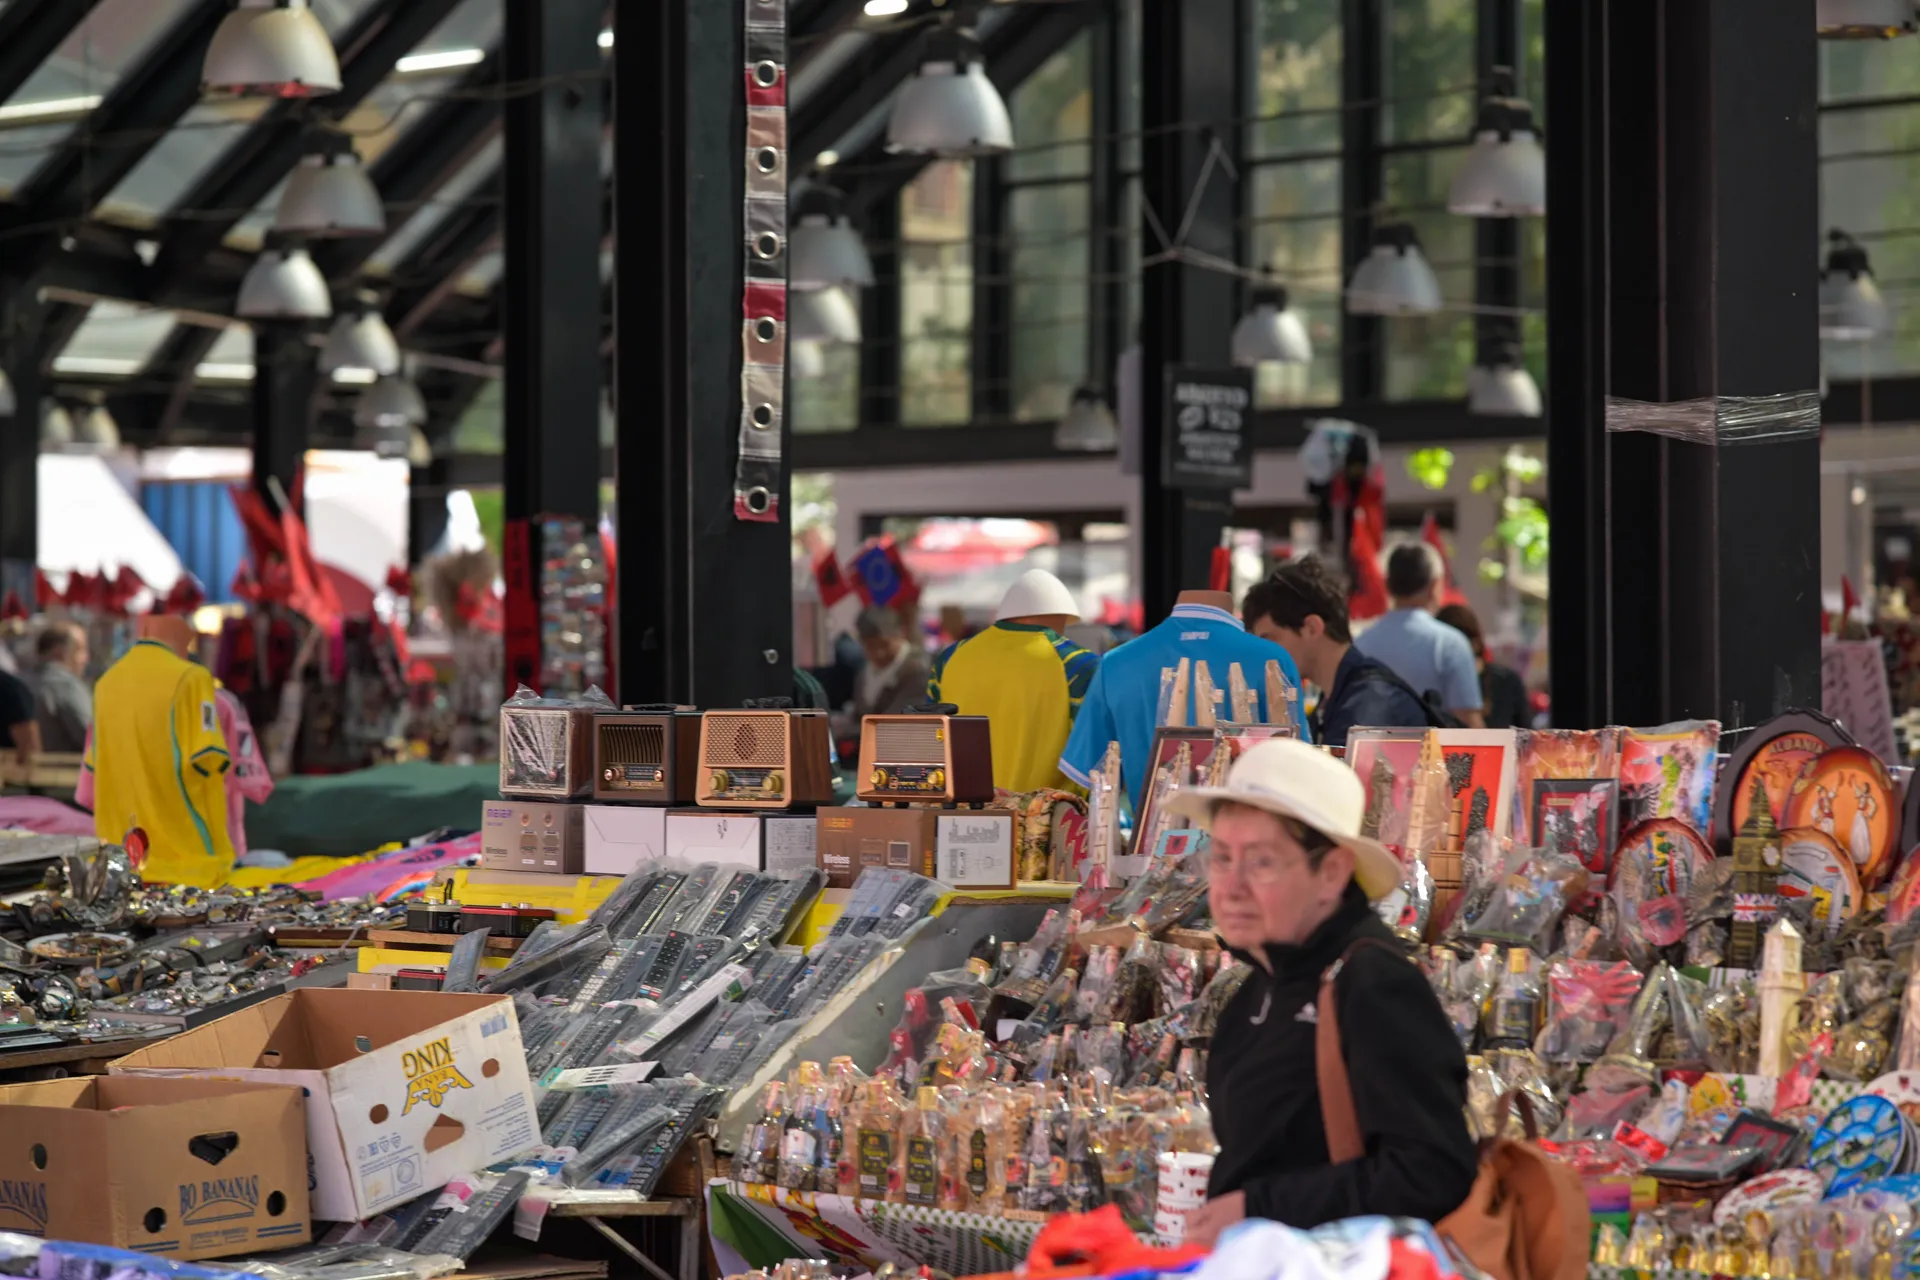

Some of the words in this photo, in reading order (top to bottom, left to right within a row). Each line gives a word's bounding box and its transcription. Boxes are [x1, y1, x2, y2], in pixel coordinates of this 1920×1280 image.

[1768, 738, 1823, 755] ALBANIA
[823, 852, 851, 865] Wireless
[401, 1036, 456, 1080] KING
[179, 1182, 198, 1219] BO
[202, 1174, 259, 1207] BANANAS
